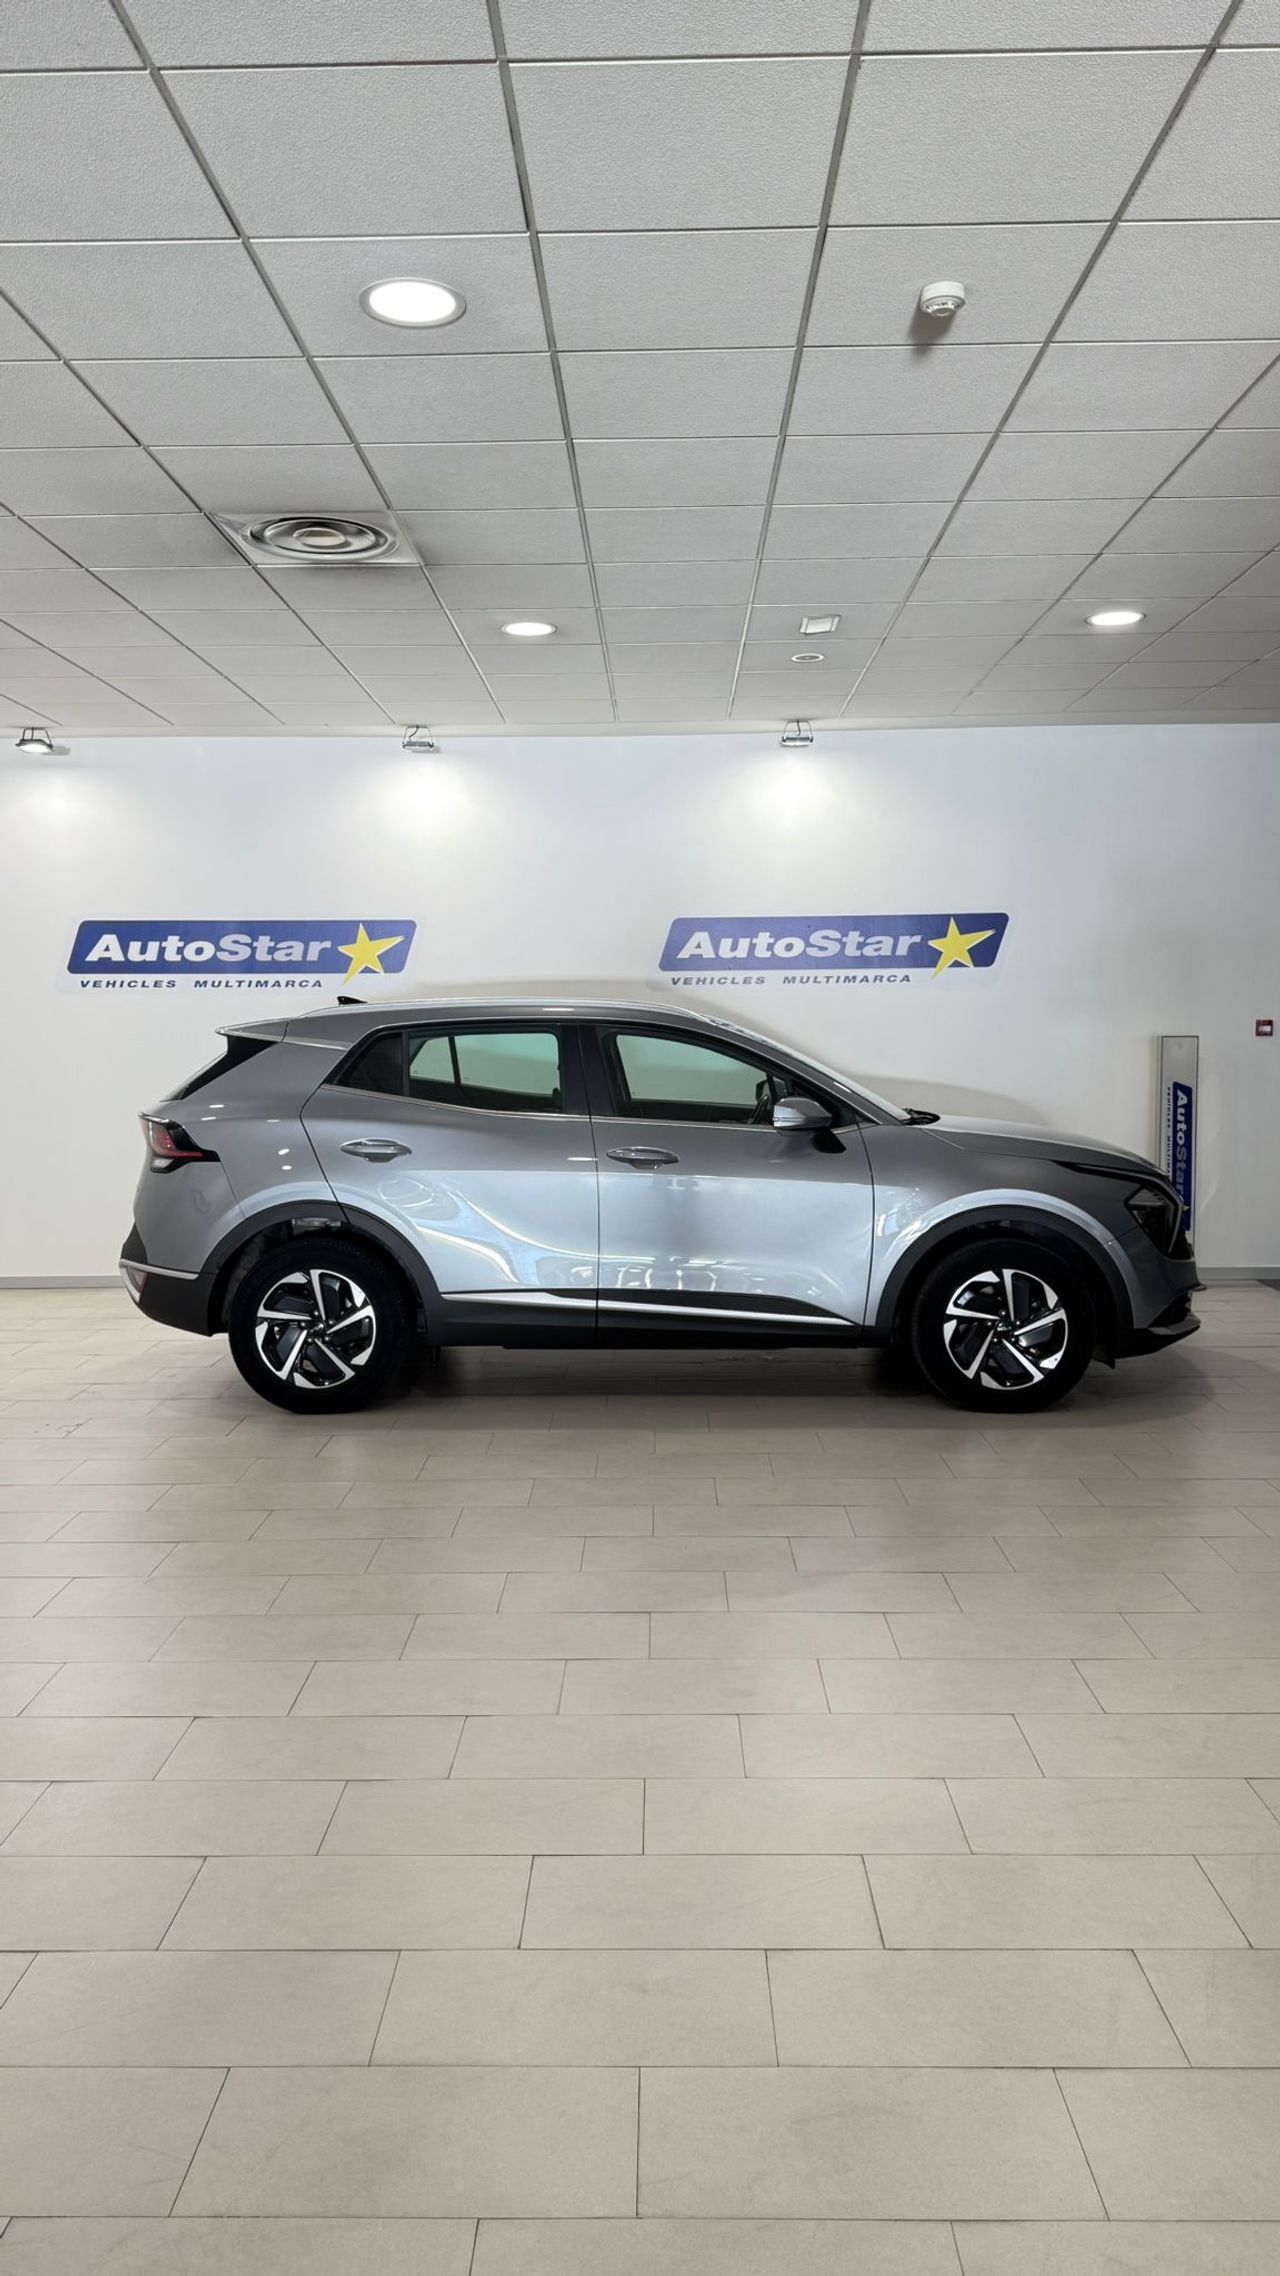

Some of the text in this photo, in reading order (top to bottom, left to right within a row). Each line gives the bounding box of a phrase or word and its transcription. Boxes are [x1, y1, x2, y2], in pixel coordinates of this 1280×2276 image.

[85, 934, 331, 962] AutoStar
[676, 929, 921, 959] AutoStar
[80, 980, 323, 988] VEHICLES MULTIMARCA
[671, 974, 912, 985] VEHICLES MULTIMARCA
[1176, 1089, 1188, 1195] AutoStar
